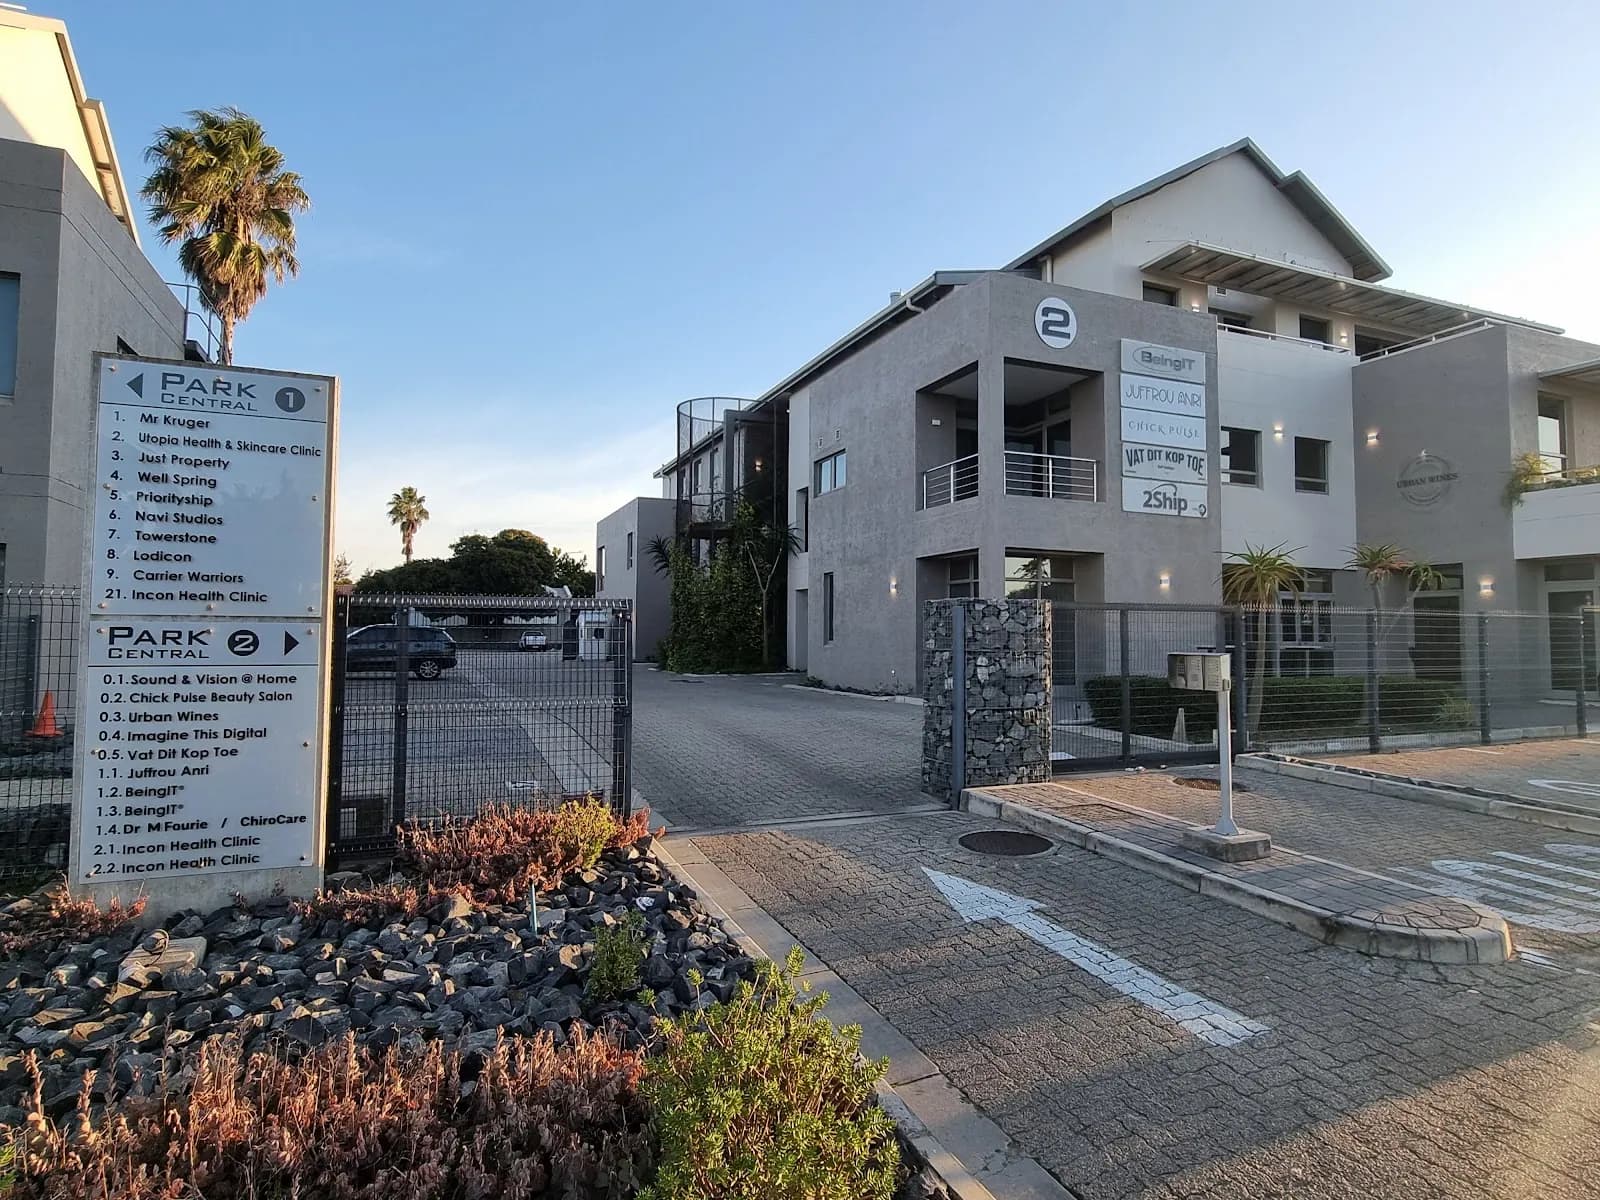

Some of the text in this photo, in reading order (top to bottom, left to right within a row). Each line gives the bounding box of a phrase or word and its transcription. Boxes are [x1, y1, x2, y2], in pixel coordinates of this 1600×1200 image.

[1041, 306, 1071, 340] 2
[1140, 350, 1196, 372] BeingIT
[161, 372, 257, 399] PARK
[161, 393, 258, 412] CENTRAL
[285, 392, 295, 409] 1
[1125, 383, 1202, 409] JUFFROU ANRI
[113, 411, 210, 429] 1. Mr Kruger
[112, 431, 322, 457] 2. Utopia Health & Skincare Clinic
[111, 450, 230, 470] 3. Just Property
[1125, 448, 1145, 467] VAT
[1147, 449, 1163, 461] DIT
[1165, 450, 1185, 464] KOP
[1186, 454, 1205, 476] TOE
[110, 470, 217, 489] 4. Well Spring
[109, 490, 214, 507] 5. Priorityship
[1142, 490, 1188, 516] 2Ship
[109, 510, 223, 525] 6. Navi Studios
[108, 529, 217, 544] 7. Towerstone
[107, 549, 192, 563] 8. Lodicon
[106, 568, 244, 583] 9. Carrier Warriors
[104, 588, 268, 602] 21. Incon Health Clinic
[108, 626, 209, 646] PARK
[233, 634, 255, 651] 2
[108, 647, 209, 659] CENTRAL
[130, 674, 177, 685] Sound
[181, 674, 191, 685] &
[196, 674, 237, 685] Vision
[241, 673, 253, 684] @
[256, 673, 297, 684] Home
[129, 692, 169, 704] Chick
[173, 692, 207, 703] Pulse
[211, 691, 255, 704] Beauty
[258, 691, 293, 702] Salon
[128, 712, 172, 723] Urban
[177, 711, 219, 722] Wines
[127, 730, 189, 743] Imagine
[193, 729, 218, 740] This
[223, 728, 267, 741] Digital
[127, 749, 154, 761] Vat
[157, 749, 176, 760] Dit
[181, 748, 209, 761] Kop
[213, 747, 239, 757] Toe
[127, 766, 176, 779] Juffrou
[180, 765, 209, 776] Anri
[123, 824, 141, 835] Dr
[148, 822, 161, 833] M
[164, 819, 209, 832] Fourie
[221, 817, 228, 829] /
[240, 814, 307, 827] ChiroCare
[122, 843, 165, 855] Incon
[170, 839, 217, 852] Health
[221, 835, 261, 848] Clinic
[122, 861, 165, 874] Incon
[169, 856, 216, 870] Health
[220, 853, 260, 866] Clinic
